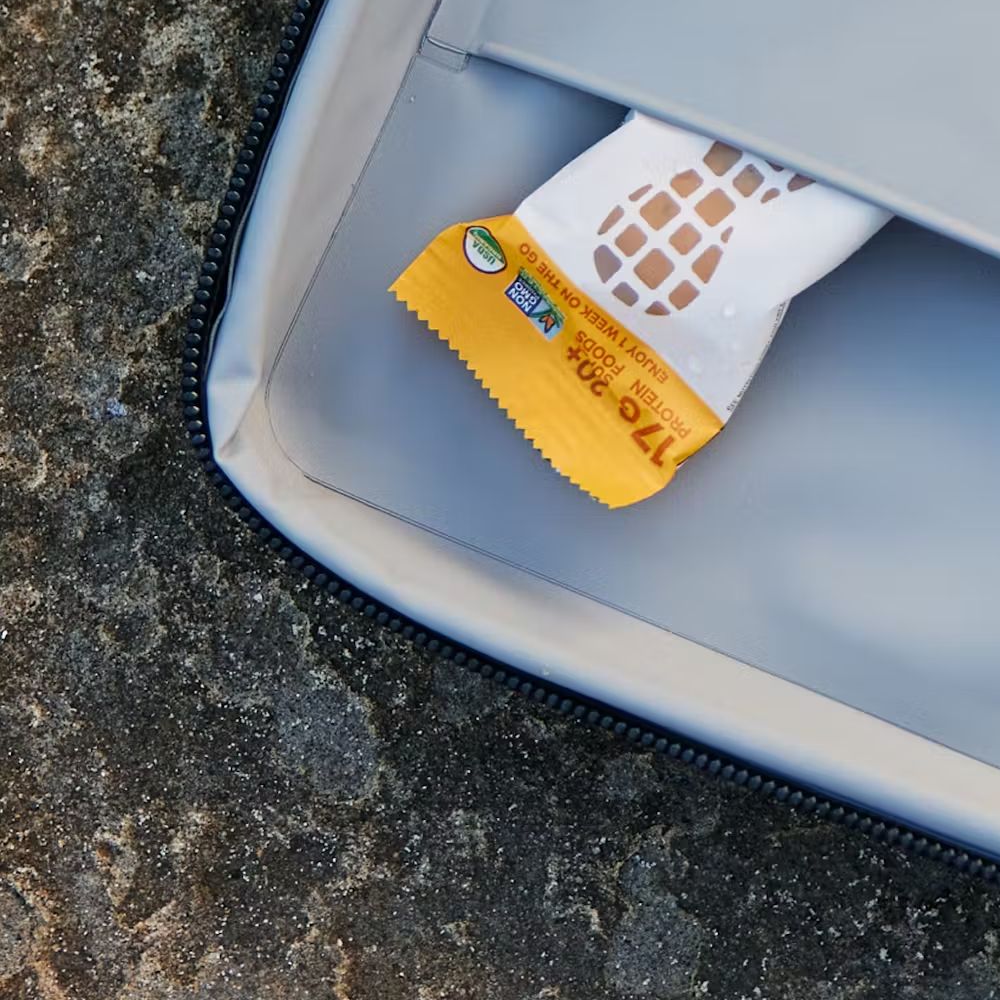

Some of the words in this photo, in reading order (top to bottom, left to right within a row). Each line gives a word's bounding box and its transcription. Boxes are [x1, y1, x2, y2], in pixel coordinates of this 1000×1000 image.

[472, 239, 496, 266] USDA
[520, 242, 539, 265] GO
[536, 262, 563, 290] THE
[507, 287, 533, 313] NON
[513, 280, 538, 306] GMO
[560, 288, 581, 310] ON
[580, 306, 620, 342] WEEK
[575, 330, 626, 377] FOODS
[618, 335, 628, 349] 1
[626, 345, 669, 384] ENJOY
[630, 379, 692, 440] PROTEIN
